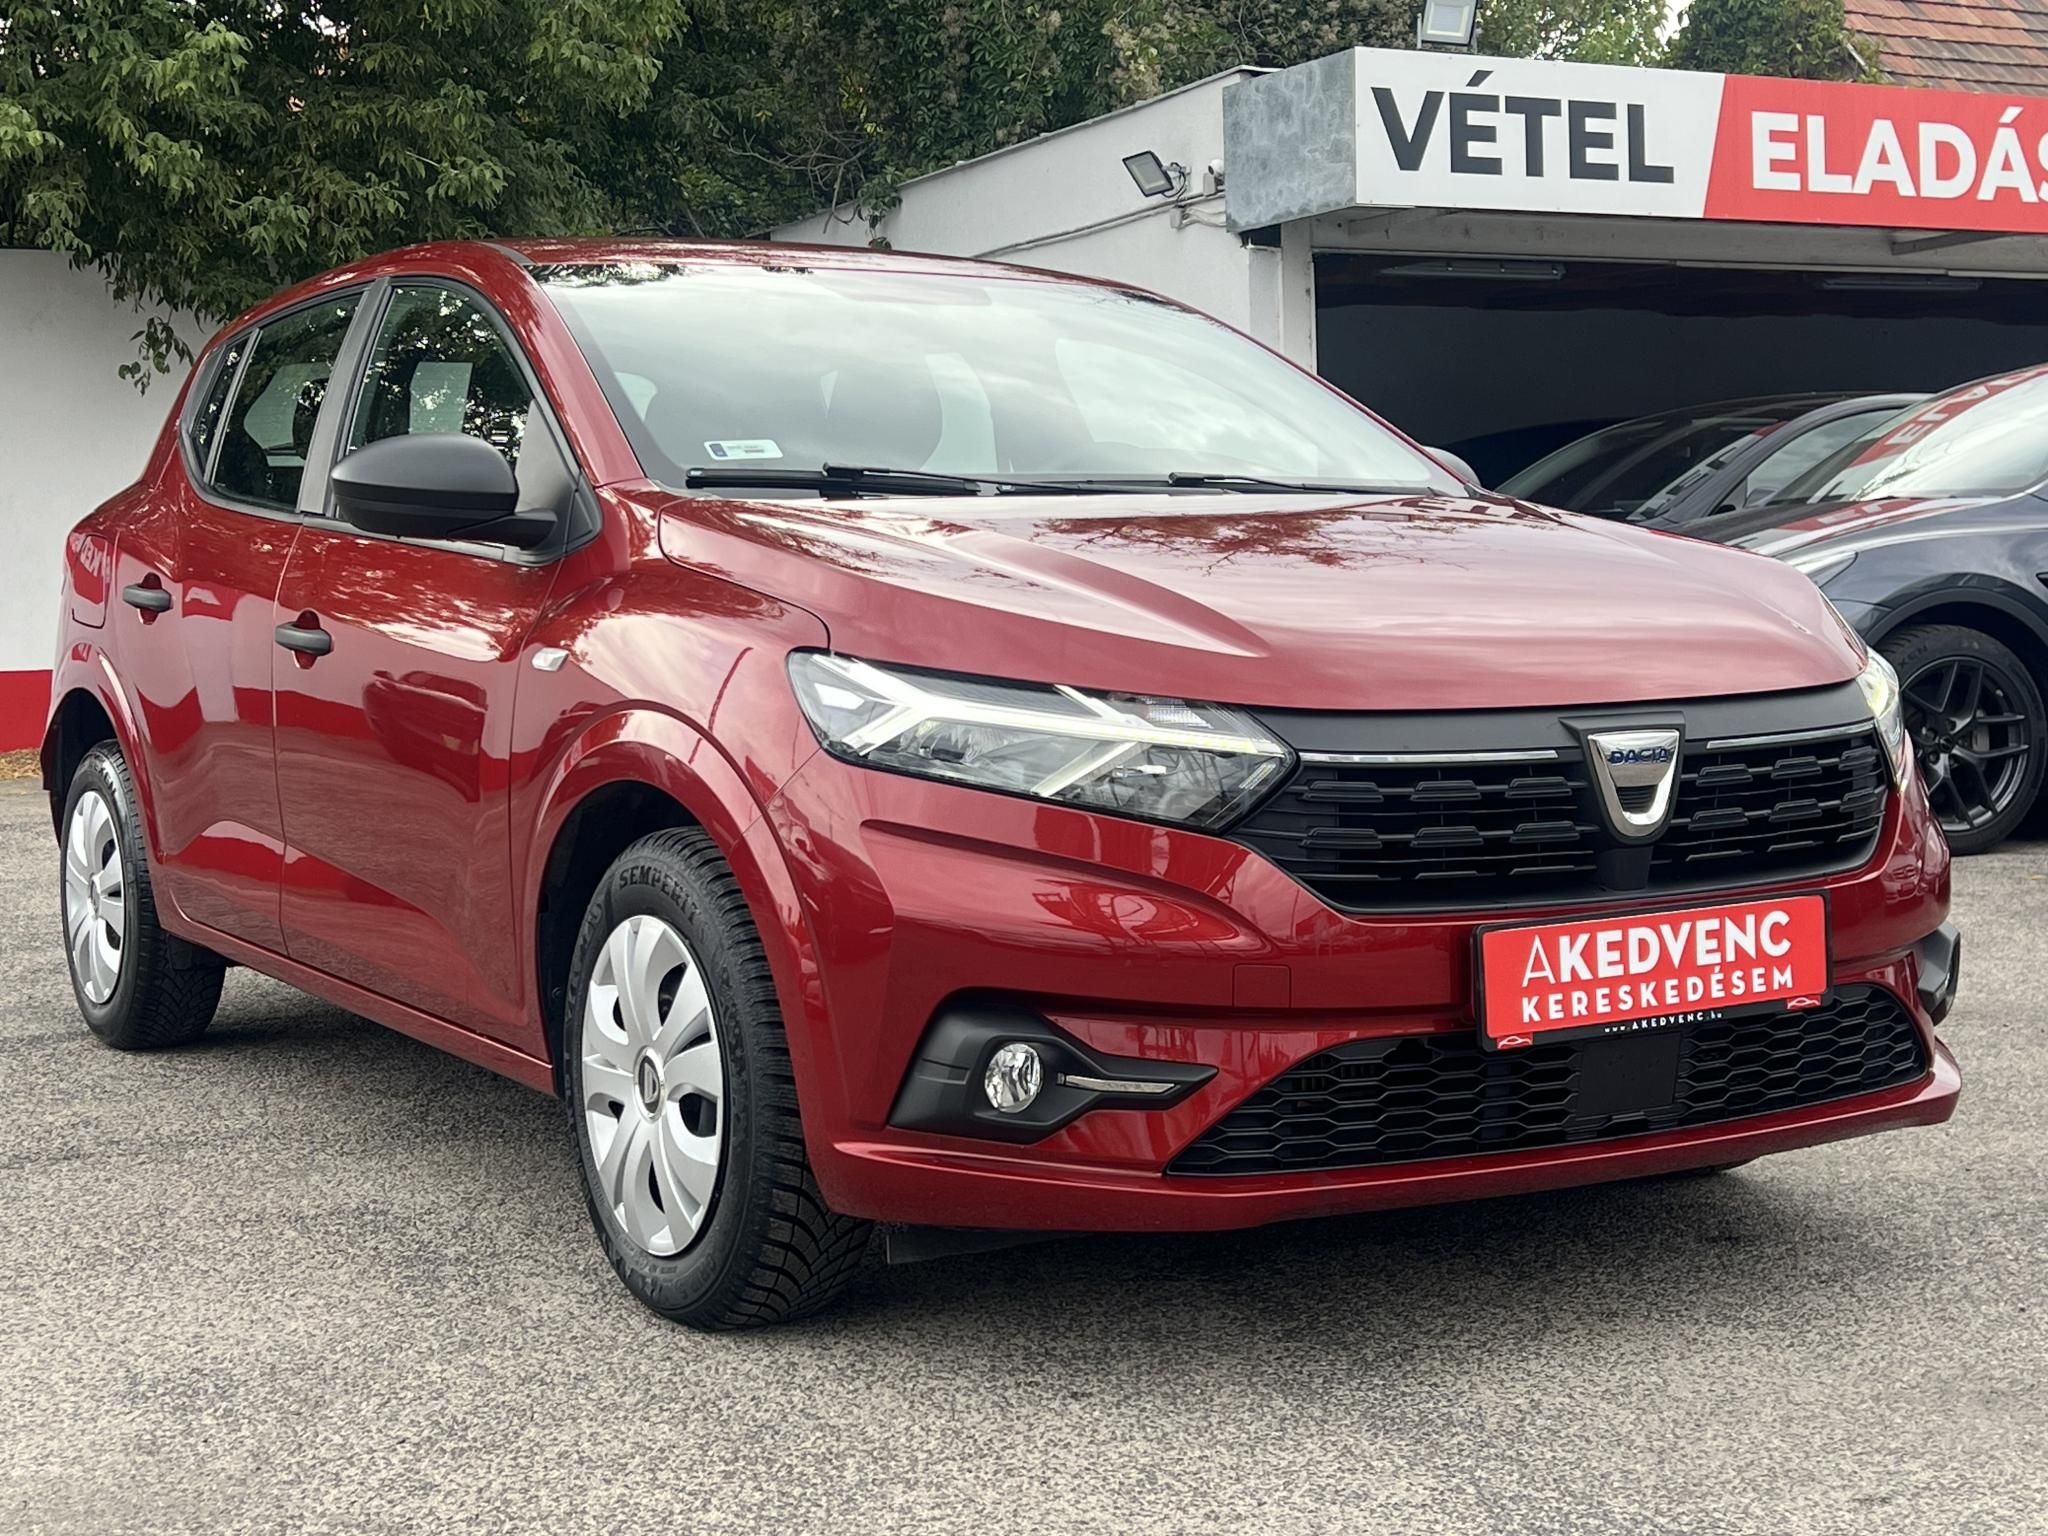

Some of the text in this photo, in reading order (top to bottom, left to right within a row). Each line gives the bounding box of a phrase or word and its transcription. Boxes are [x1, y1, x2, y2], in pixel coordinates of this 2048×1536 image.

[1370, 69, 2048, 203] VÉTEL ELADÁ
[1609, 746, 1670, 766] DACIA
[619, 865, 700, 925] SEMPERIT
[1522, 964, 1794, 1024] KERESKEDÉSEM
